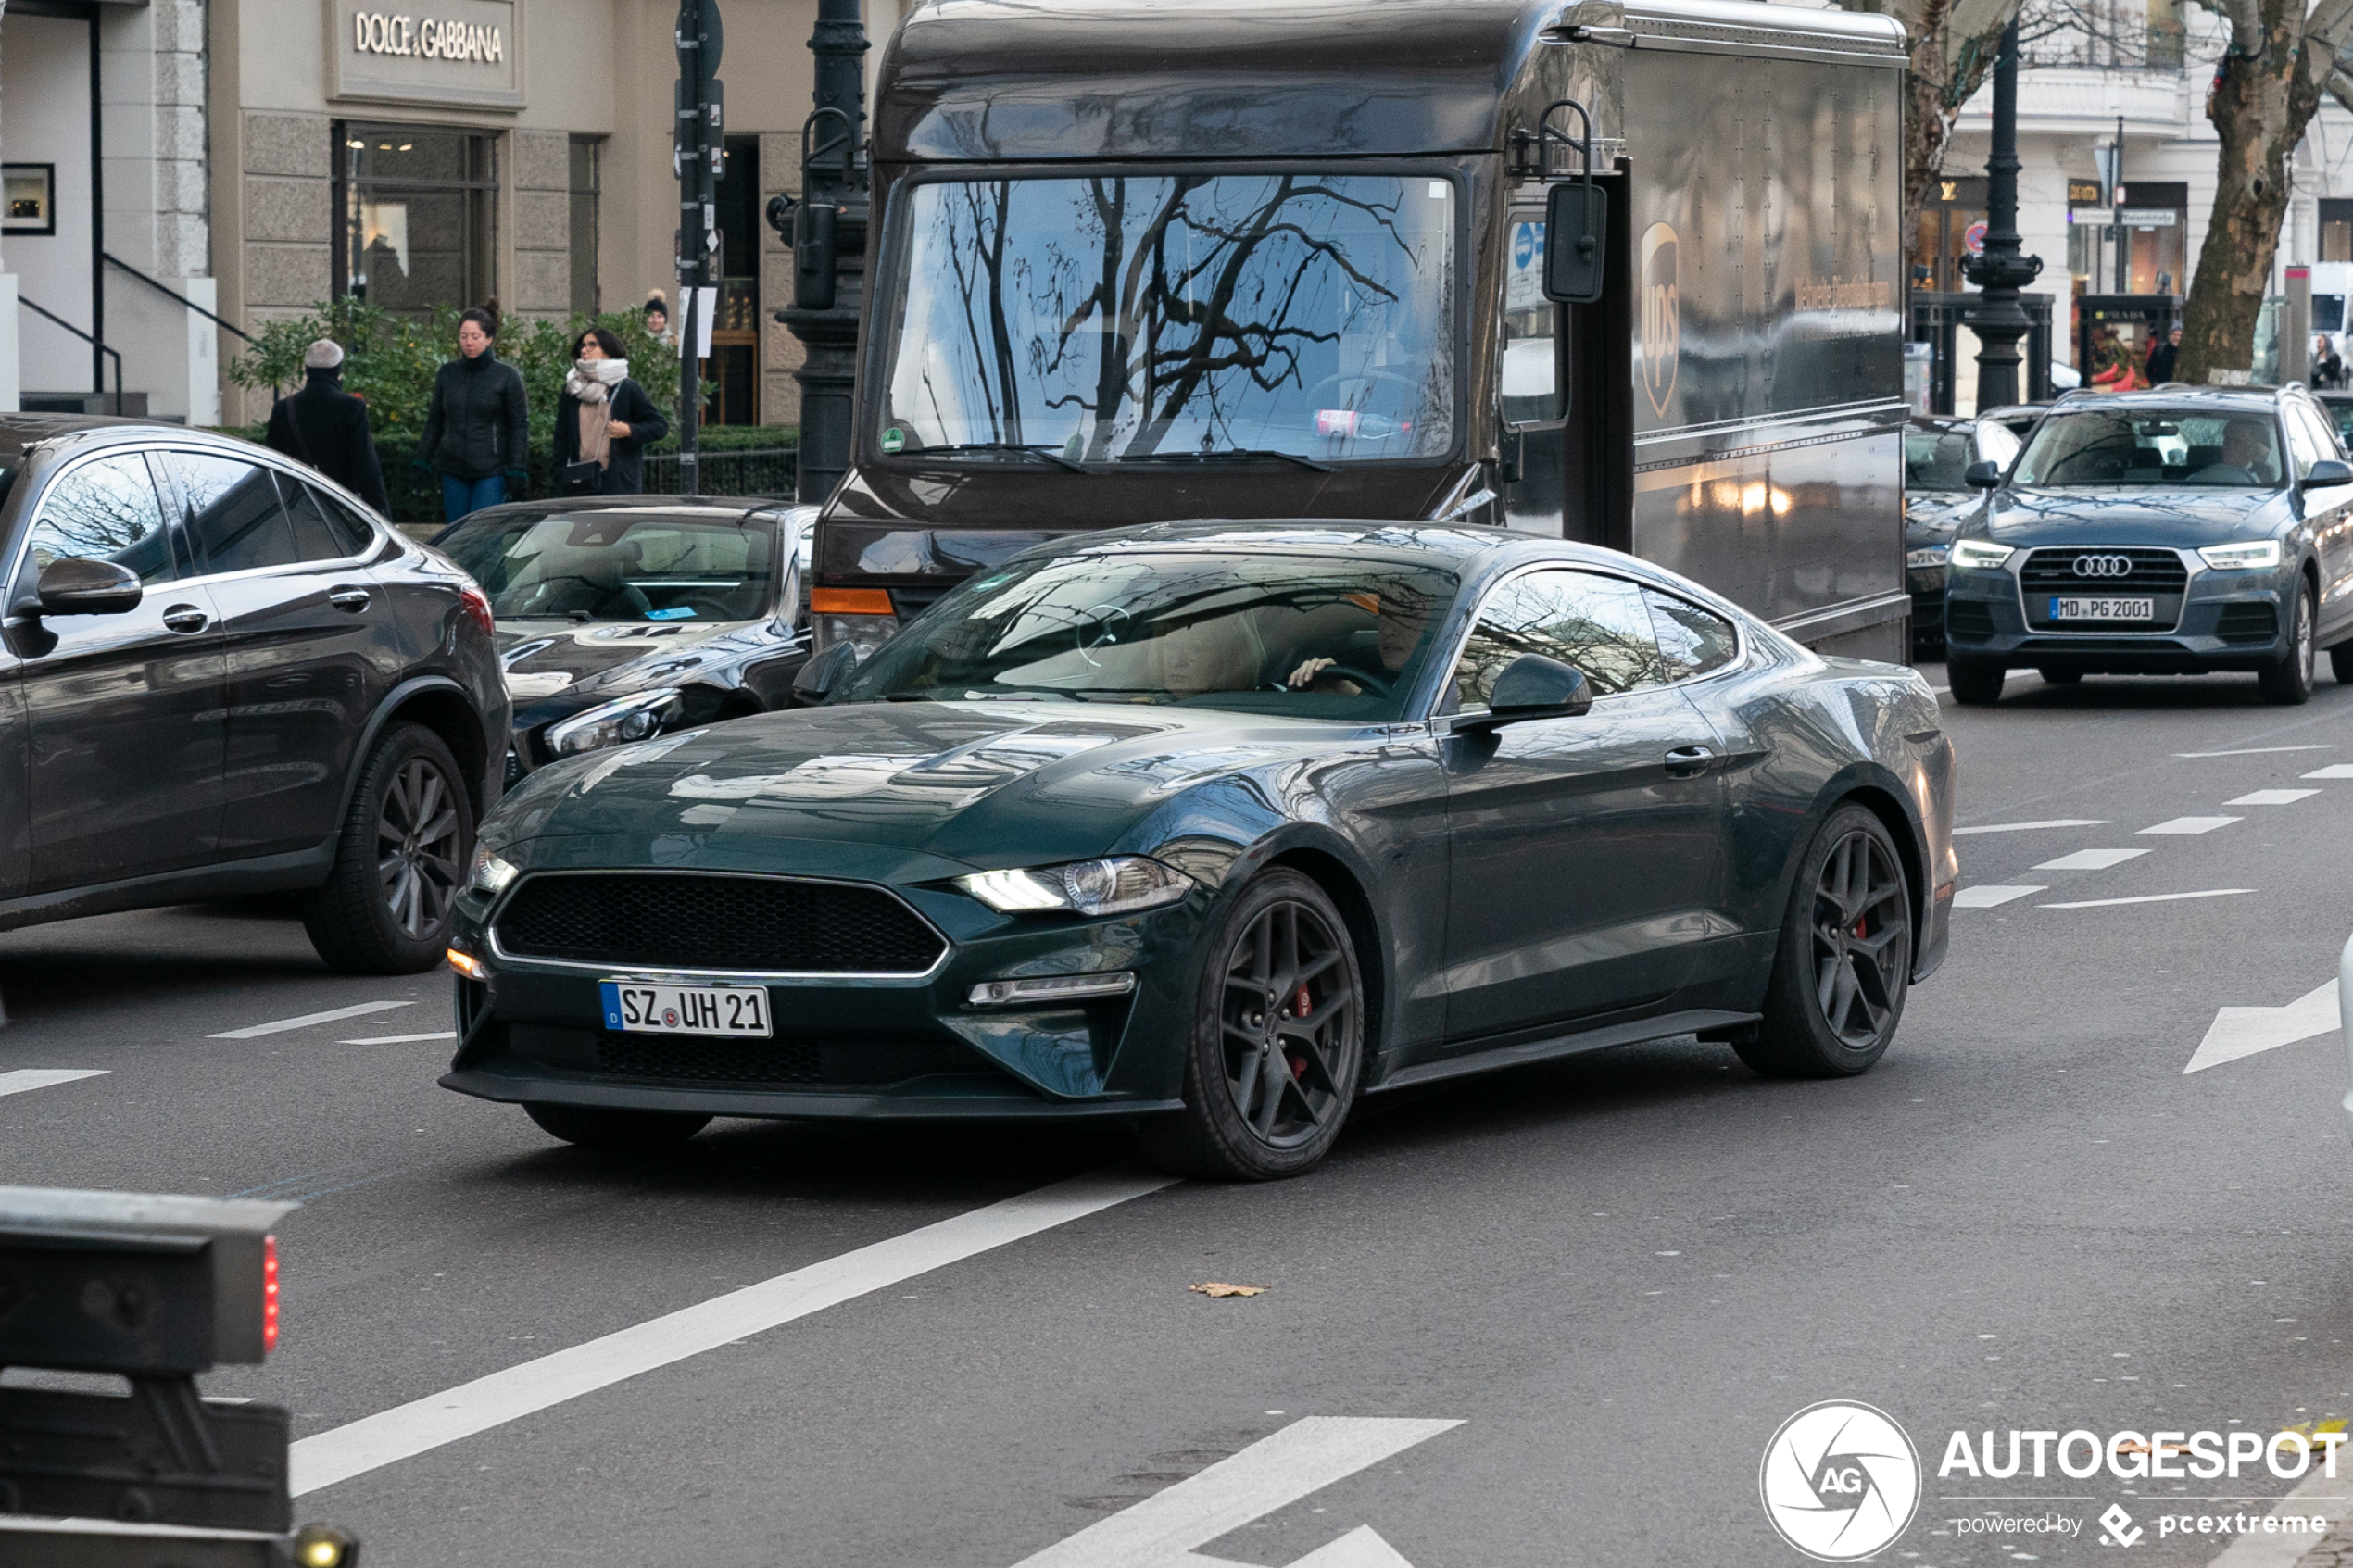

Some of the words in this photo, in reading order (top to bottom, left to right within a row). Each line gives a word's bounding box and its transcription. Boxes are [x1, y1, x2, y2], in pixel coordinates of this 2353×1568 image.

[356, 11, 411, 55] DOLCE
[421, 18, 503, 62] GABBANA
[1644, 283, 1676, 388] ups
[2059, 600, 2079, 617] MD
[2090, 600, 2109, 617] PG
[2112, 600, 2150, 617] 2001
[610, 1012, 619, 1024] D
[622, 989, 661, 1025] SZ
[679, 992, 720, 1029] UH
[726, 994, 765, 1030] 21
